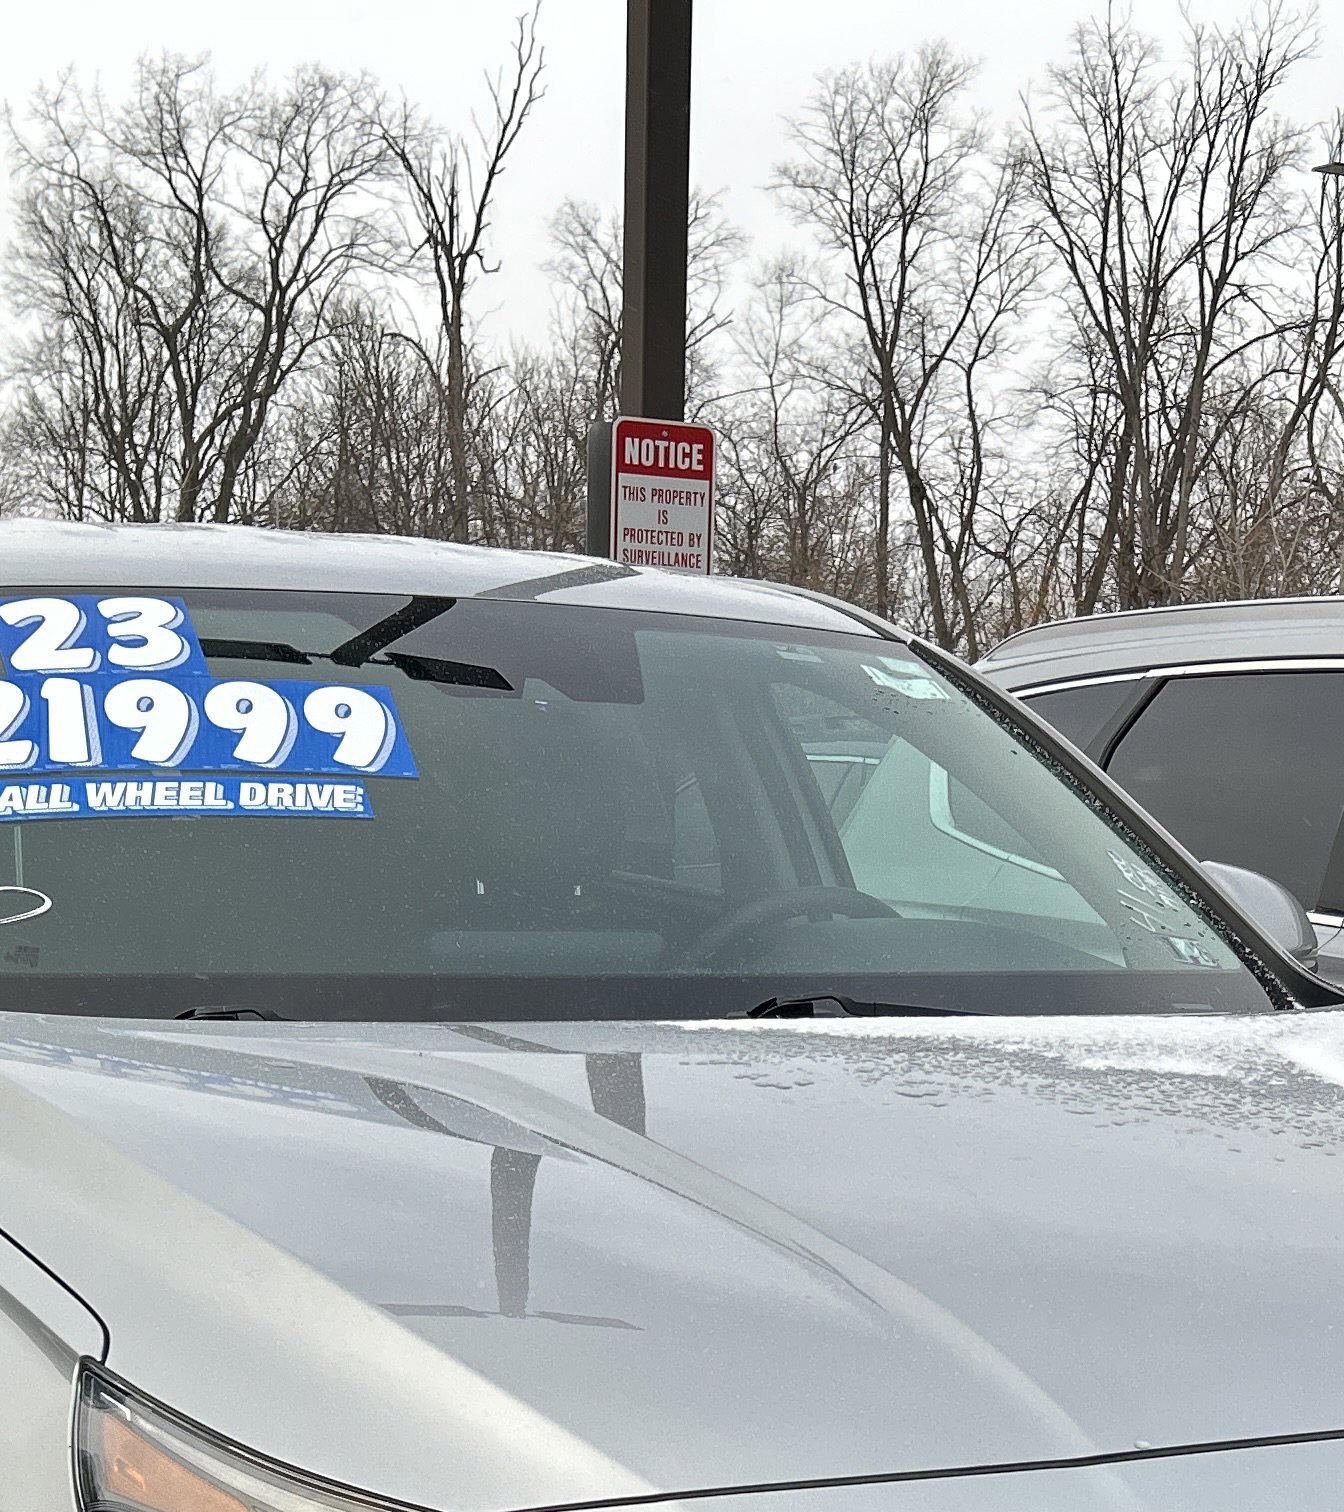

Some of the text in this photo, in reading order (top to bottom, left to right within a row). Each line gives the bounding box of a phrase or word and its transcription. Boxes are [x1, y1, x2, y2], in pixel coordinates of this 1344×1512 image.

[624, 437, 704, 471] NOTICE
[622, 485, 706, 507] THIS PROPERTY
[657, 509, 669, 525] IS
[623, 528, 702, 548] PROTECTED BY
[622, 549, 702, 569] SURVEILLANCE
[85, 782, 235, 810] WHEEL
[239, 782, 365, 812] DRIVE
